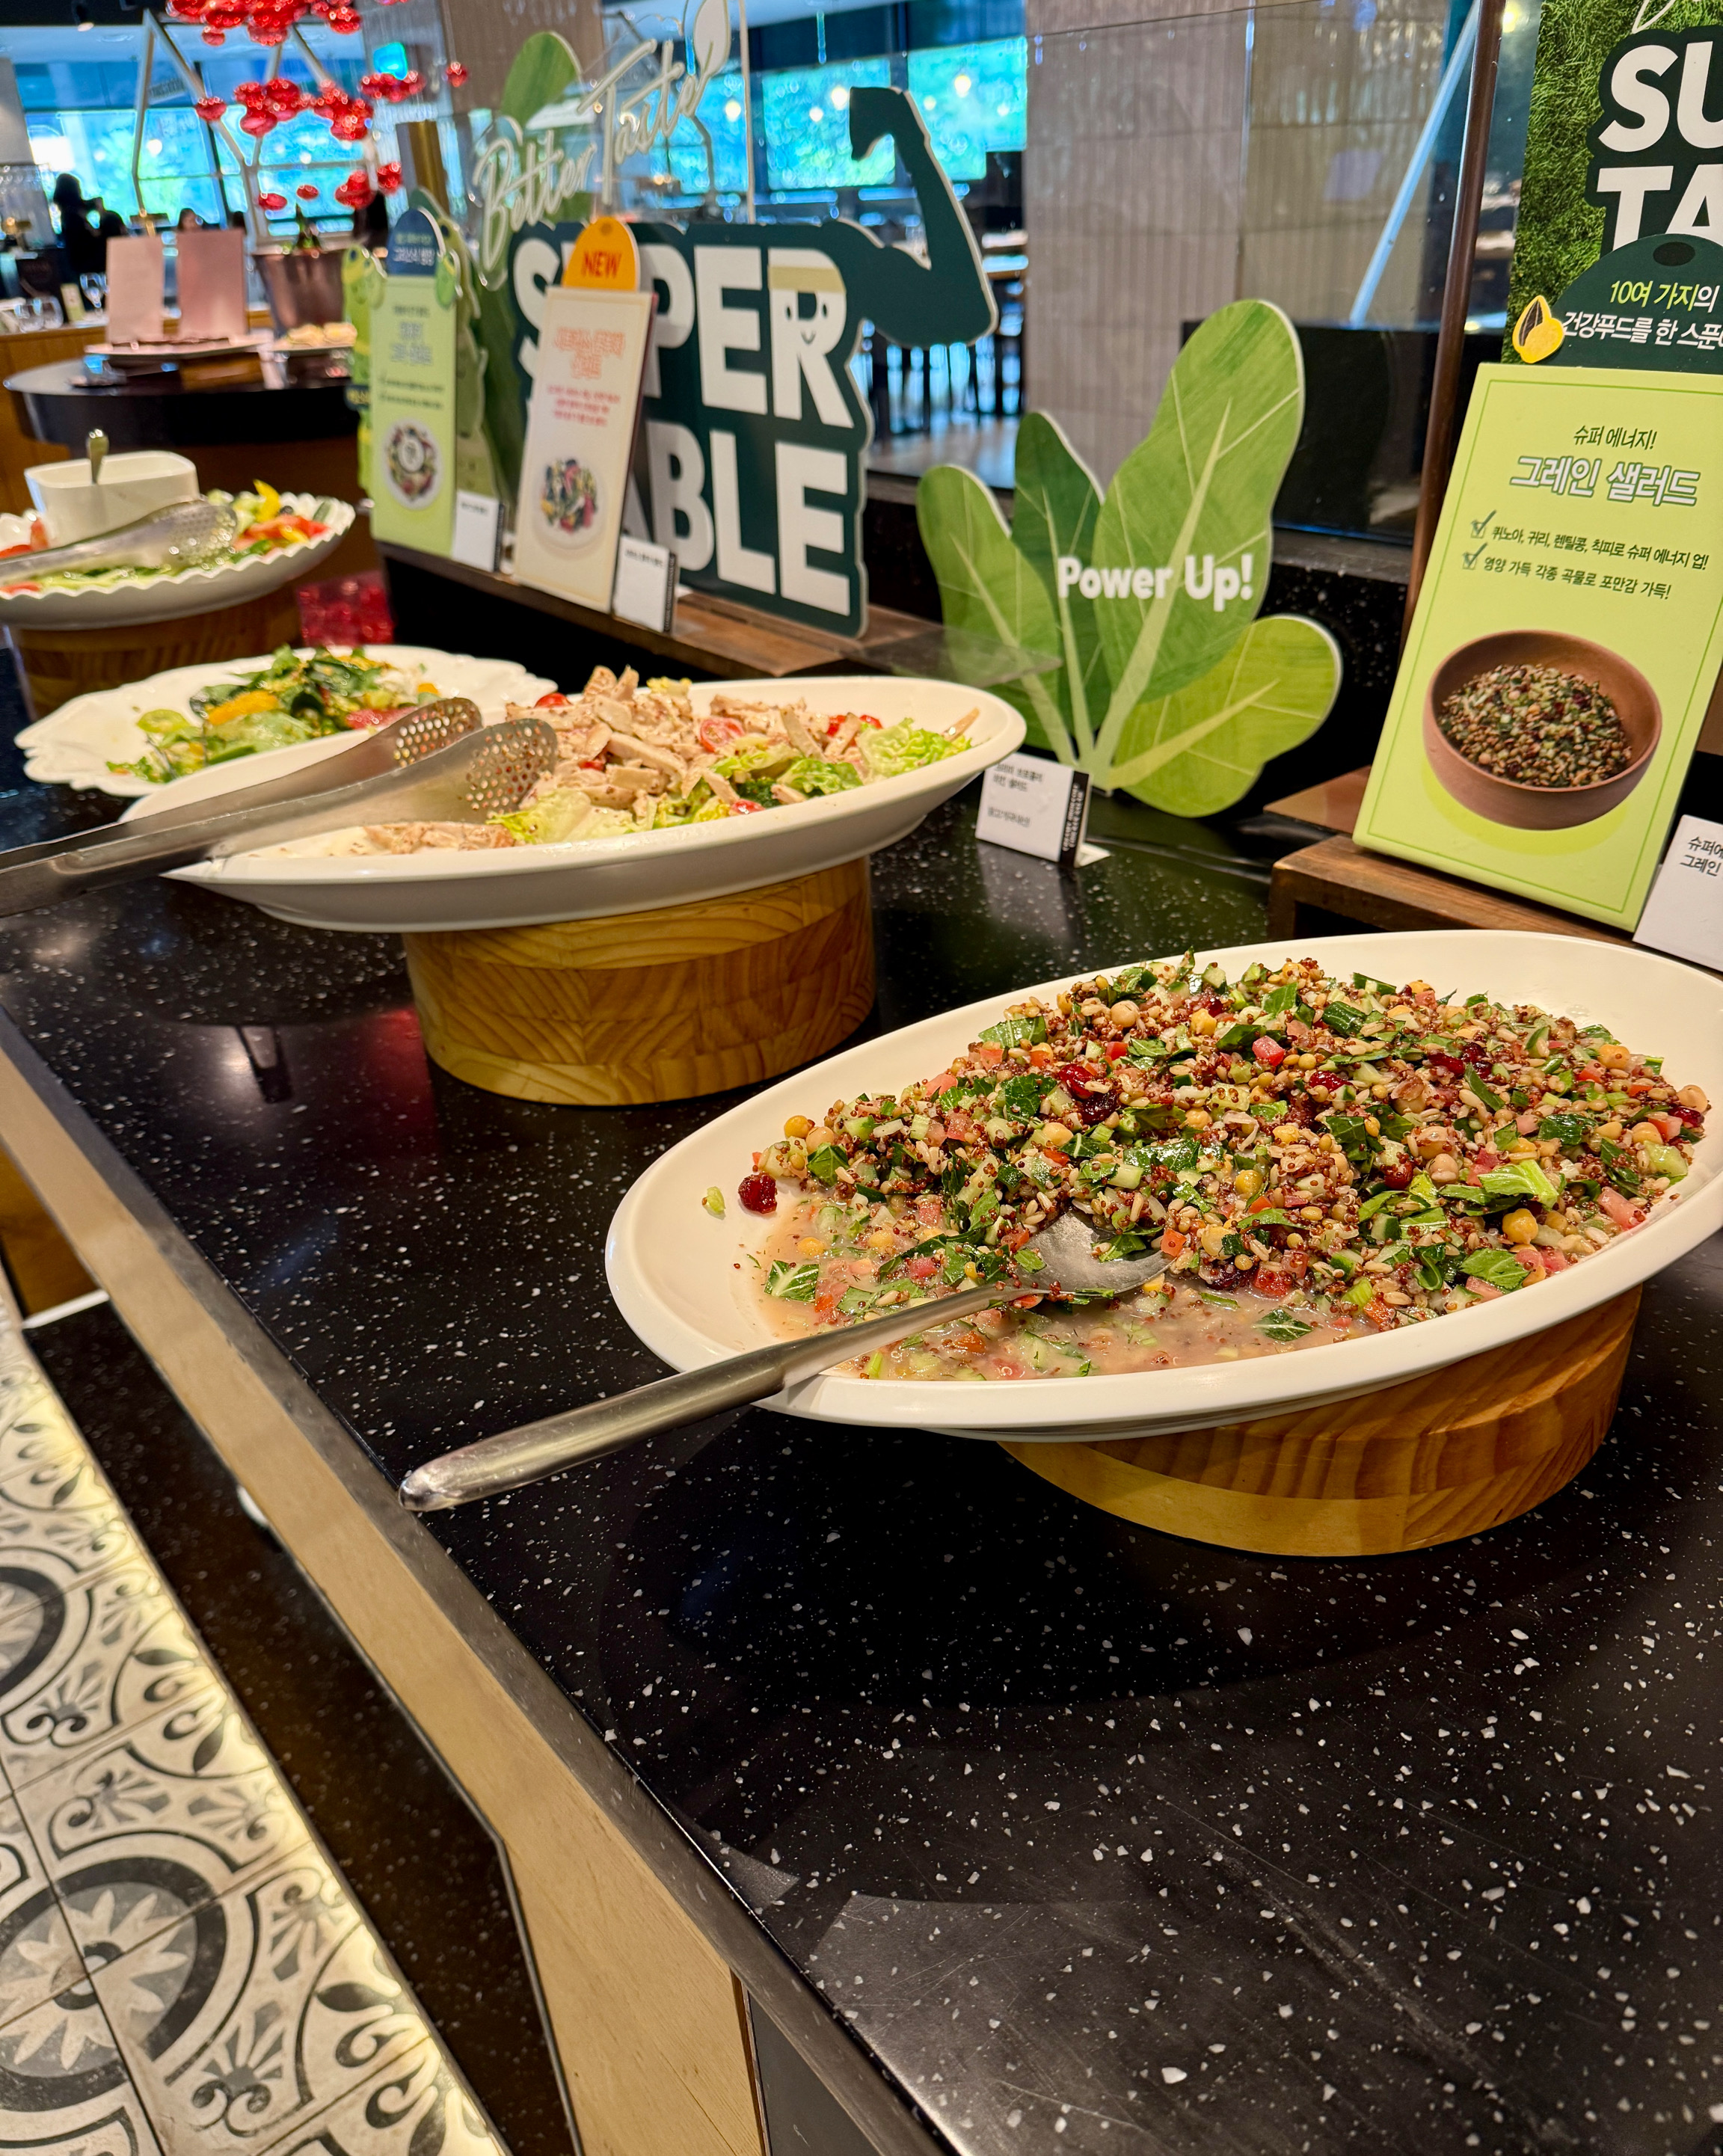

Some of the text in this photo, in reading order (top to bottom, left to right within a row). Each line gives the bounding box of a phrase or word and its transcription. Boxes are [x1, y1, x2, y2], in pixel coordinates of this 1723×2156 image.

[581, 250, 622, 279] NEW
[1610, 280, 1720, 313] 10여 가지의
[513, 237, 854, 429] SPER
[1563, 311, 1723, 350] 건강푸드를 한 스푼
[1573, 426, 1657, 449] 슈퍼 에너지!
[1509, 455, 1701, 507] 그레인 샐러드
[622, 420, 851, 616] BLE
[1492, 526, 1525, 544] 퀴노아,
[1527, 530, 1551, 548] 귀리,
[1553, 534, 1588, 553] 렌틸콩,
[1627, 544, 1652, 562] 슈퍼
[1653, 548, 1691, 568] 에너지
[1692, 553, 1710, 571] 업!
[1057, 553, 1254, 612] Power Up!
[1484, 556, 1672, 600] 영양 가득 각종 곡물로 포만감 가득!
[1680, 854, 1722, 877] 그레인
